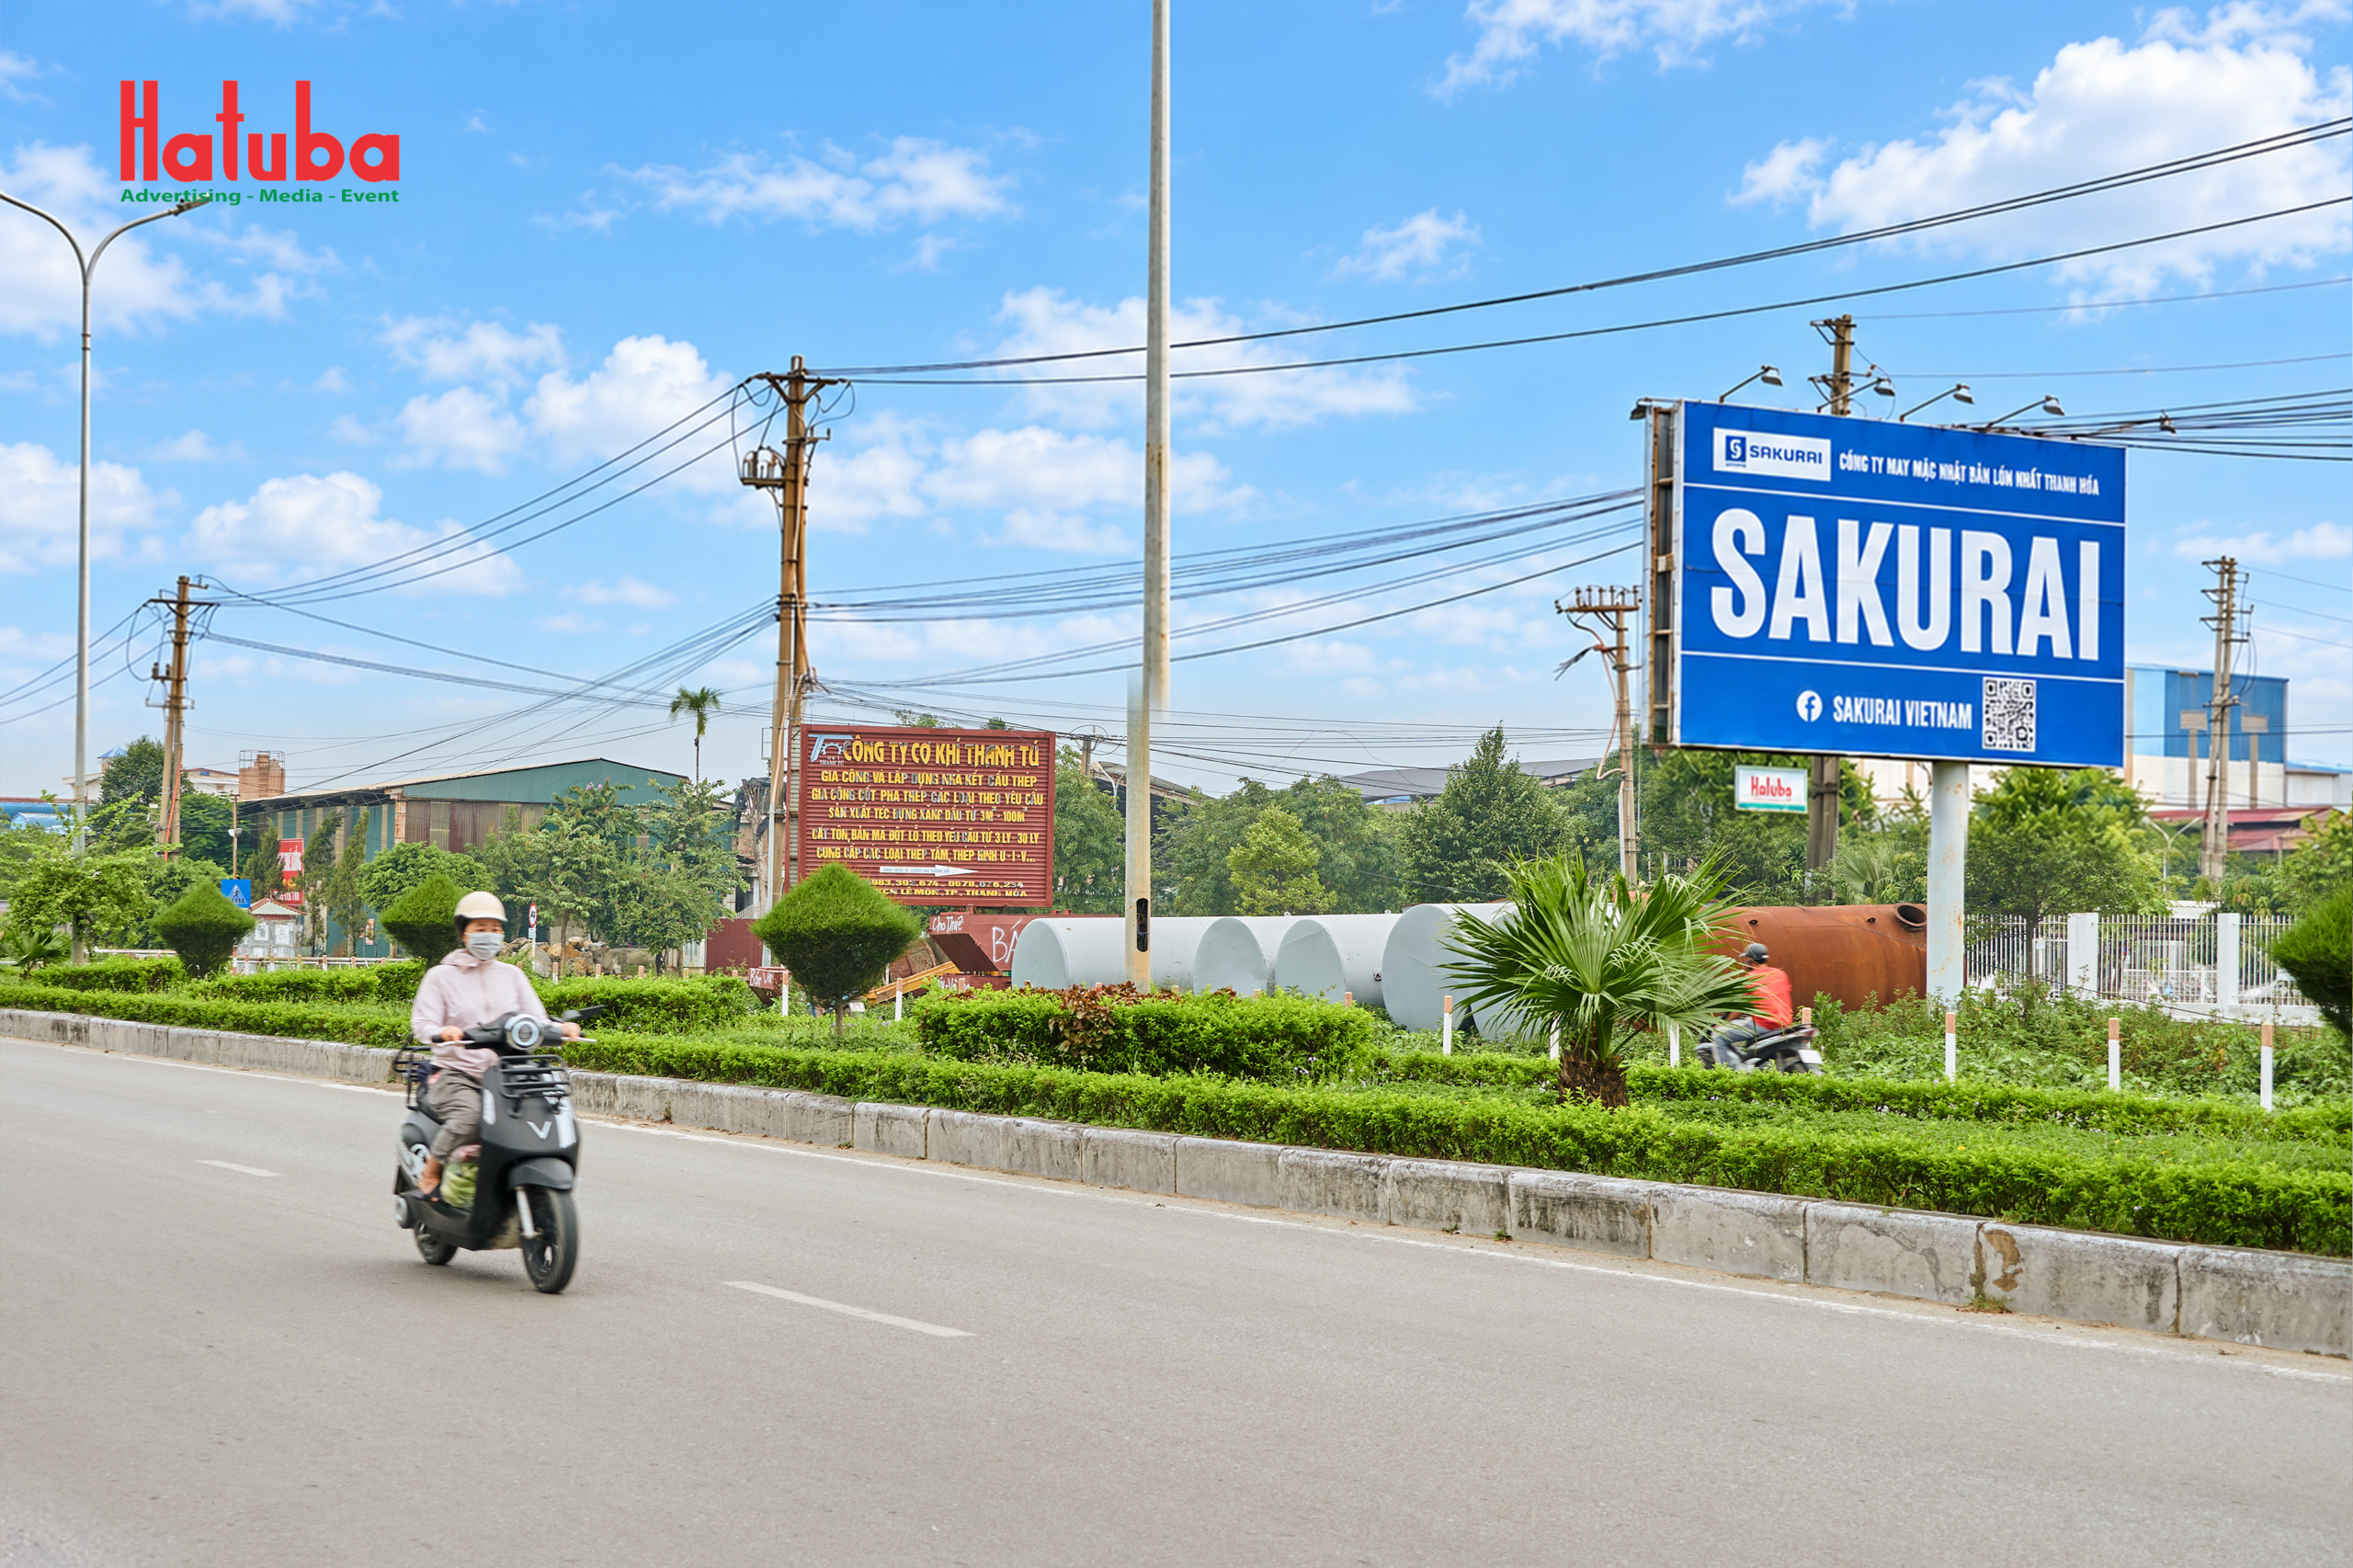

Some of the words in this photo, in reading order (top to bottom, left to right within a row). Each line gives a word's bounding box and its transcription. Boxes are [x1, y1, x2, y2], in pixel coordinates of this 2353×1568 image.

[1749, 445, 1823, 465] SAKURAI
[1870, 456, 1884, 474] TY
[1886, 457, 1910, 477] MAY
[2044, 473, 2077, 494] THANH
[2078, 474, 2100, 495] HÓA
[1711, 507, 2100, 661] SAKURAI
[1833, 696, 1901, 726] SAKURAI
[1904, 700, 1972, 730] VIETNAM
[843, 734, 884, 763] CÔNG
[889, 743, 909, 766] TY
[936, 737, 961, 767] KHÍ
[1019, 740, 1040, 767] TÚ
[821, 770, 838, 782] GIA
[842, 768, 870, 783] CÔNG
[873, 769, 885, 784] VÀ
[941, 769, 962, 786] NHÀ
[965, 769, 983, 786] KẾT
[1012, 771, 1037, 788] THÉP
[811, 788, 827, 801] GIA
[830, 786, 856, 801] CÔNG
[880, 790, 900, 802] PHA
[930, 787, 950, 803] CÁC
[953, 791, 974, 805] LOẠI
[978, 792, 1001, 804] THEO
[1004, 790, 1022, 804] YÊU
[828, 802, 847, 818] SẢN
[922, 830, 943, 843] THEO
[945, 827, 960, 843] YÊU
[995, 832, 1001, 844] 3
[1017, 833, 1029, 845] 30
[1029, 833, 1040, 845] LY
[816, 846, 841, 859] CUNG
[863, 844, 881, 860] CÁC
[883, 847, 904, 863] LOẠI
[905, 844, 927, 860] THÉP
[952, 846, 975, 861] THÉP
[870, 880, 939, 888] 983.392.674
[1005, 889, 1028, 897] HÓA
[932, 915, 946, 932] Cho
[946, 915, 964, 933] Thuê
